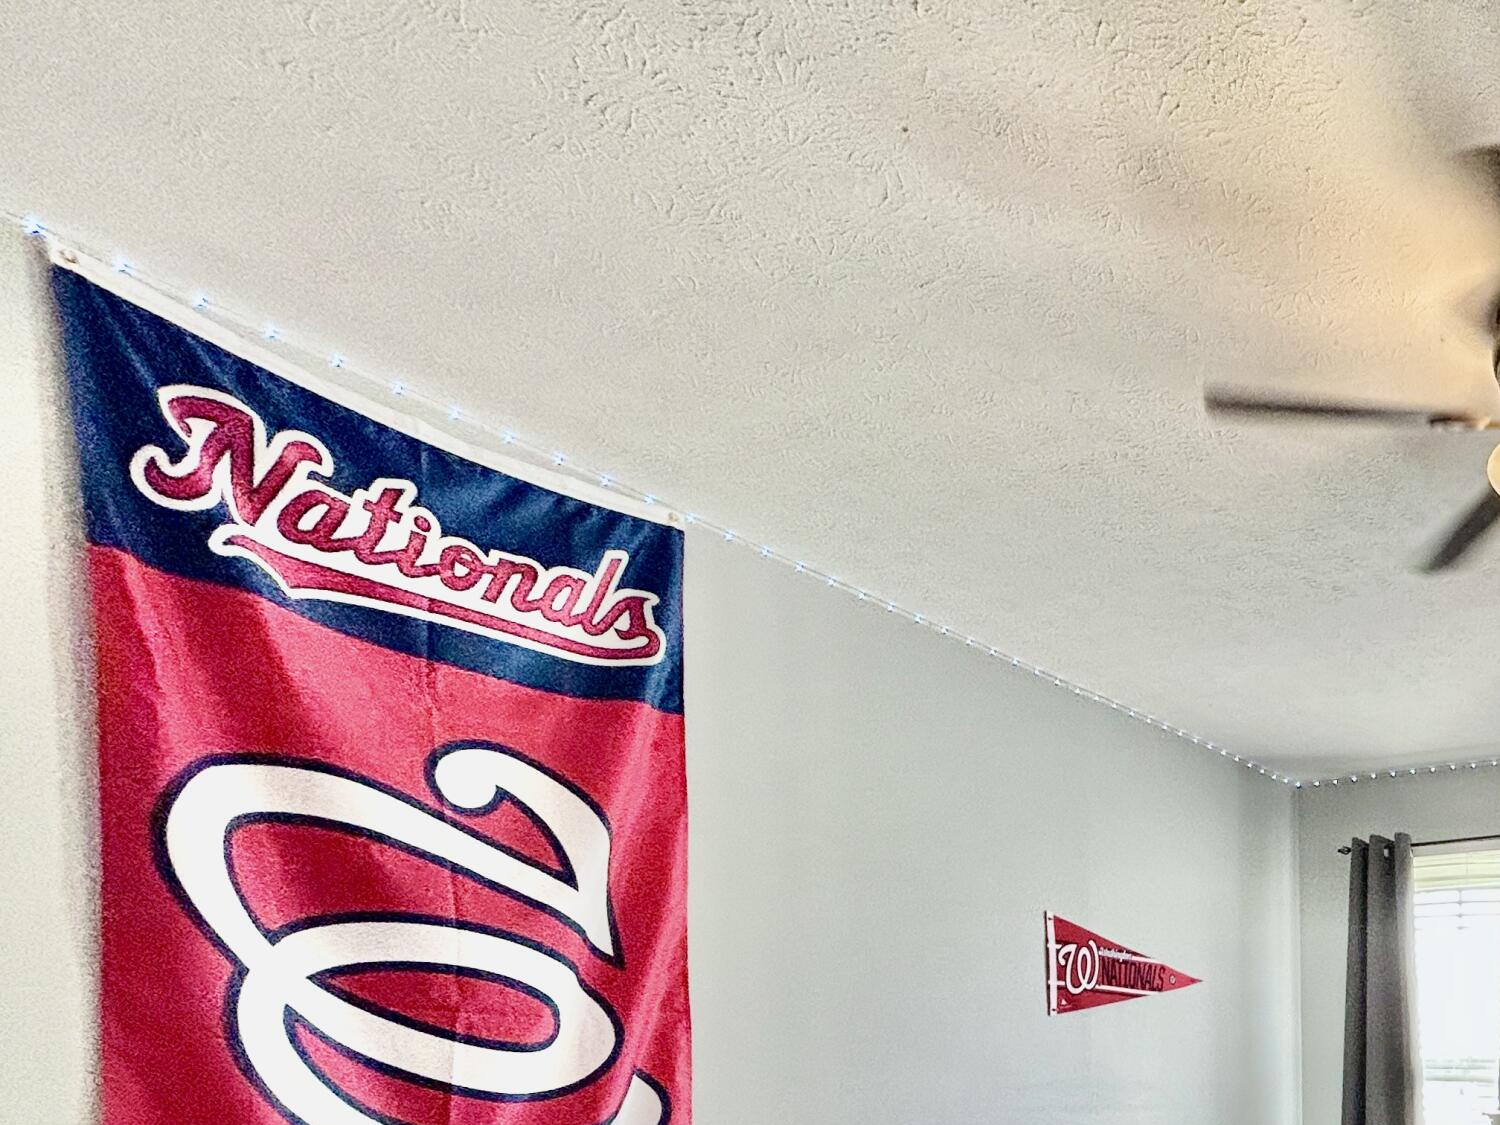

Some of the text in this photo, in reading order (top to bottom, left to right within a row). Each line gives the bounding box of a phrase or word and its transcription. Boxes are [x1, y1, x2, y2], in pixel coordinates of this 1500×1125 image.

[130, 384, 668, 665] Nationals
[1058, 940, 1099, 994] W
[1102, 960, 1166, 991] NATIONALS
